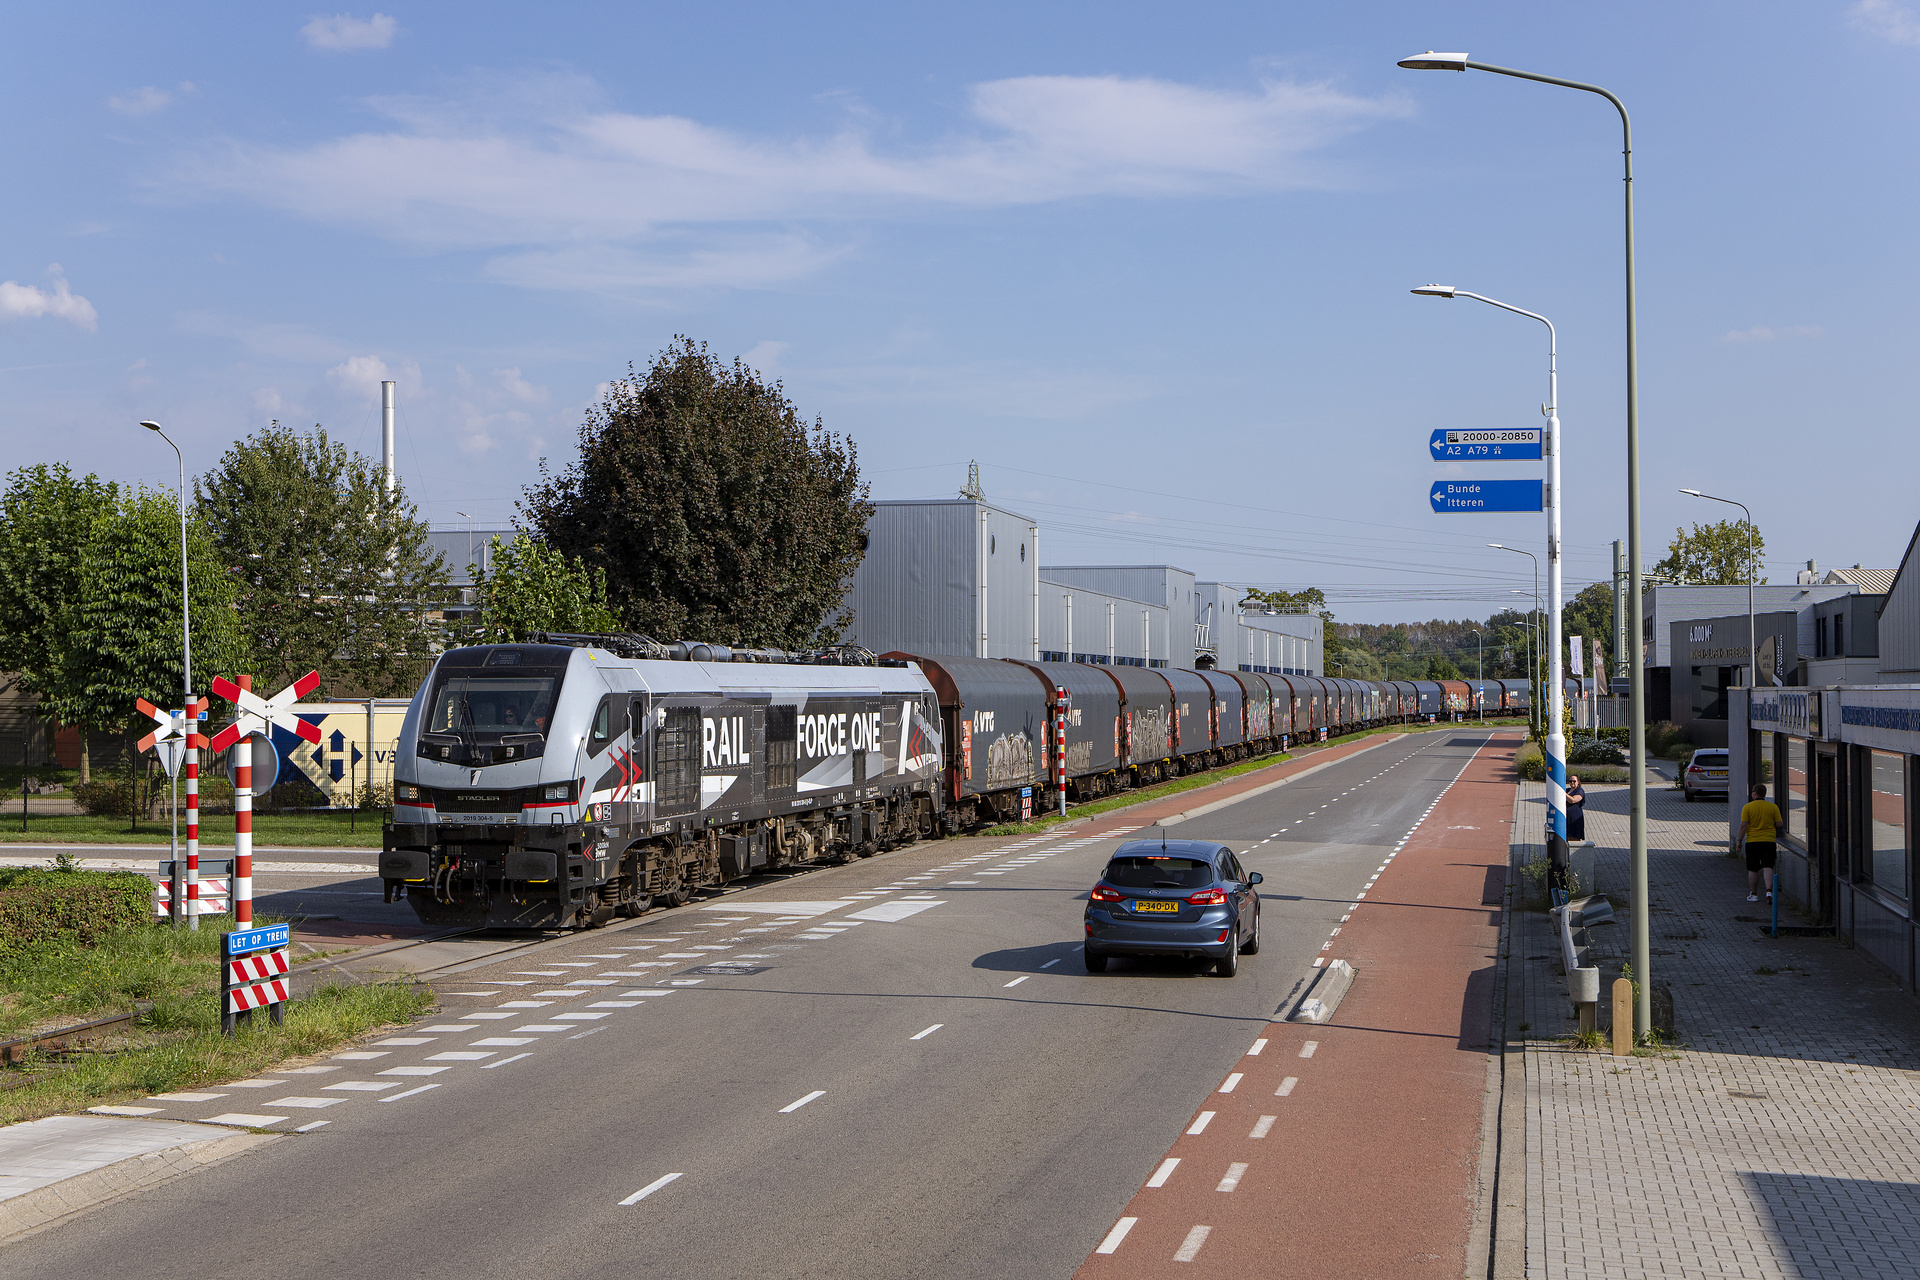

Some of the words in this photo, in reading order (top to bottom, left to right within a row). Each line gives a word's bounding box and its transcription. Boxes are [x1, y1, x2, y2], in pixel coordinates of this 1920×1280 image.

[1463, 432, 1534, 441] 20000-20850
[1446, 446, 1461, 455] A2
[1467, 446, 1488, 455] A79
[1447, 484, 1481, 493] Bunde
[1447, 498, 1484, 507] Itteren
[979, 711, 995, 732] VTG
[702, 716, 750, 769] RAIL
[796, 713, 847, 760] FORCE
[851, 712, 881, 752] ONE
[1138, 902, 1176, 911] P-340-DK
[232, 937, 246, 949] LET
[251, 934, 262, 945] OP
[266, 930, 288, 943] TREIN
